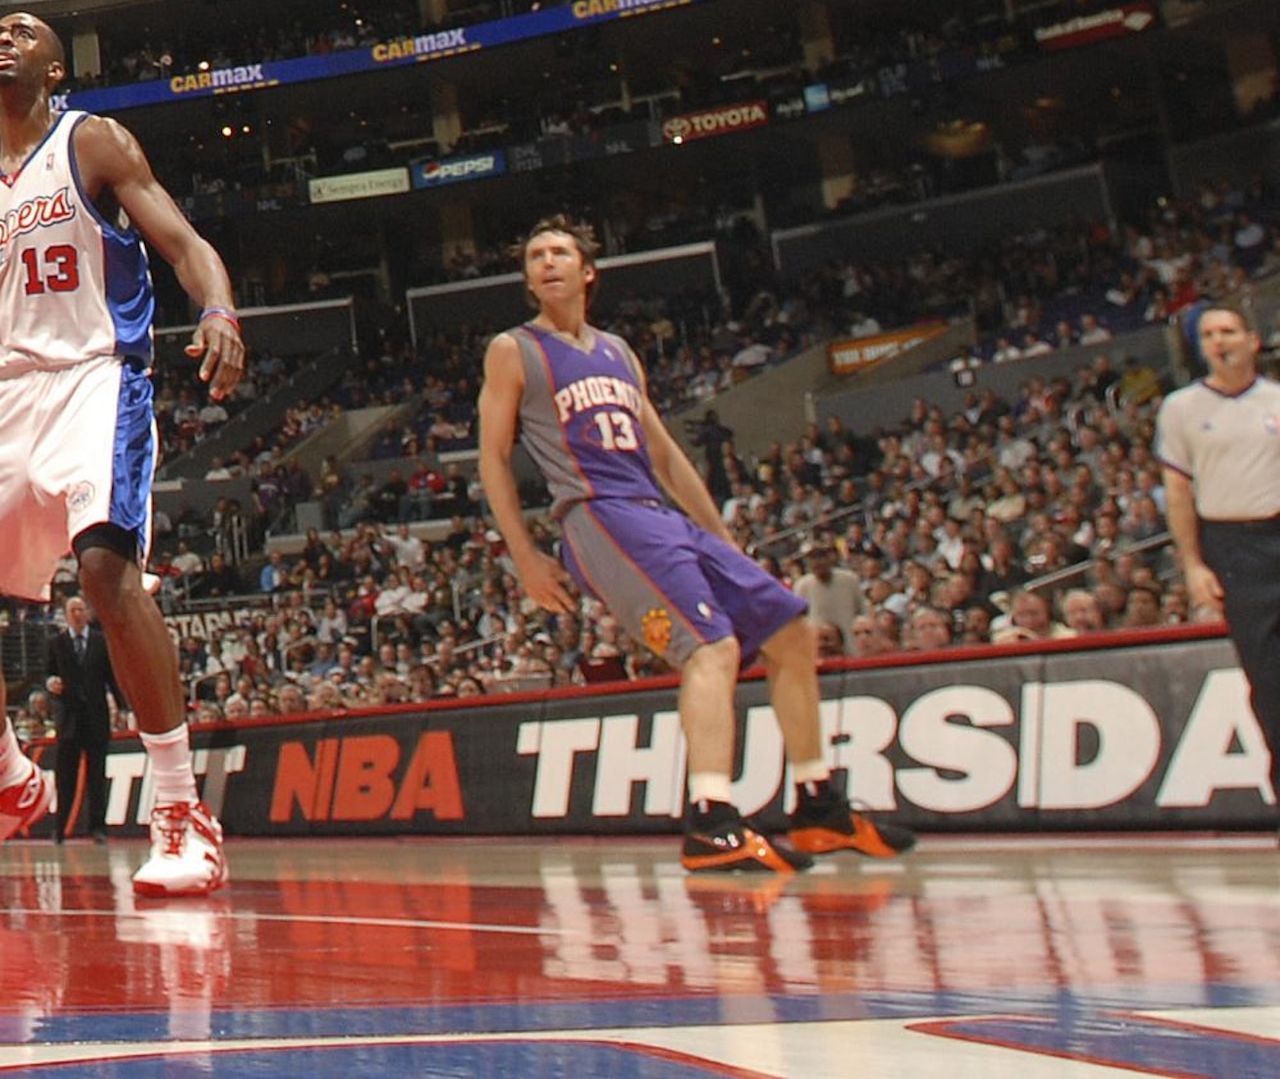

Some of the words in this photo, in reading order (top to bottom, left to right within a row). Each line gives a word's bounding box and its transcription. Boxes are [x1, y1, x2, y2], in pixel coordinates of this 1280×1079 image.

[691, 105, 765, 132] TOYOTA
[440, 156, 495, 178] PEPSI
[22, 244, 80, 295] 13
[594, 411, 638, 452] 13
[105, 745, 246, 825] TT
[269, 730, 465, 823] NBA
